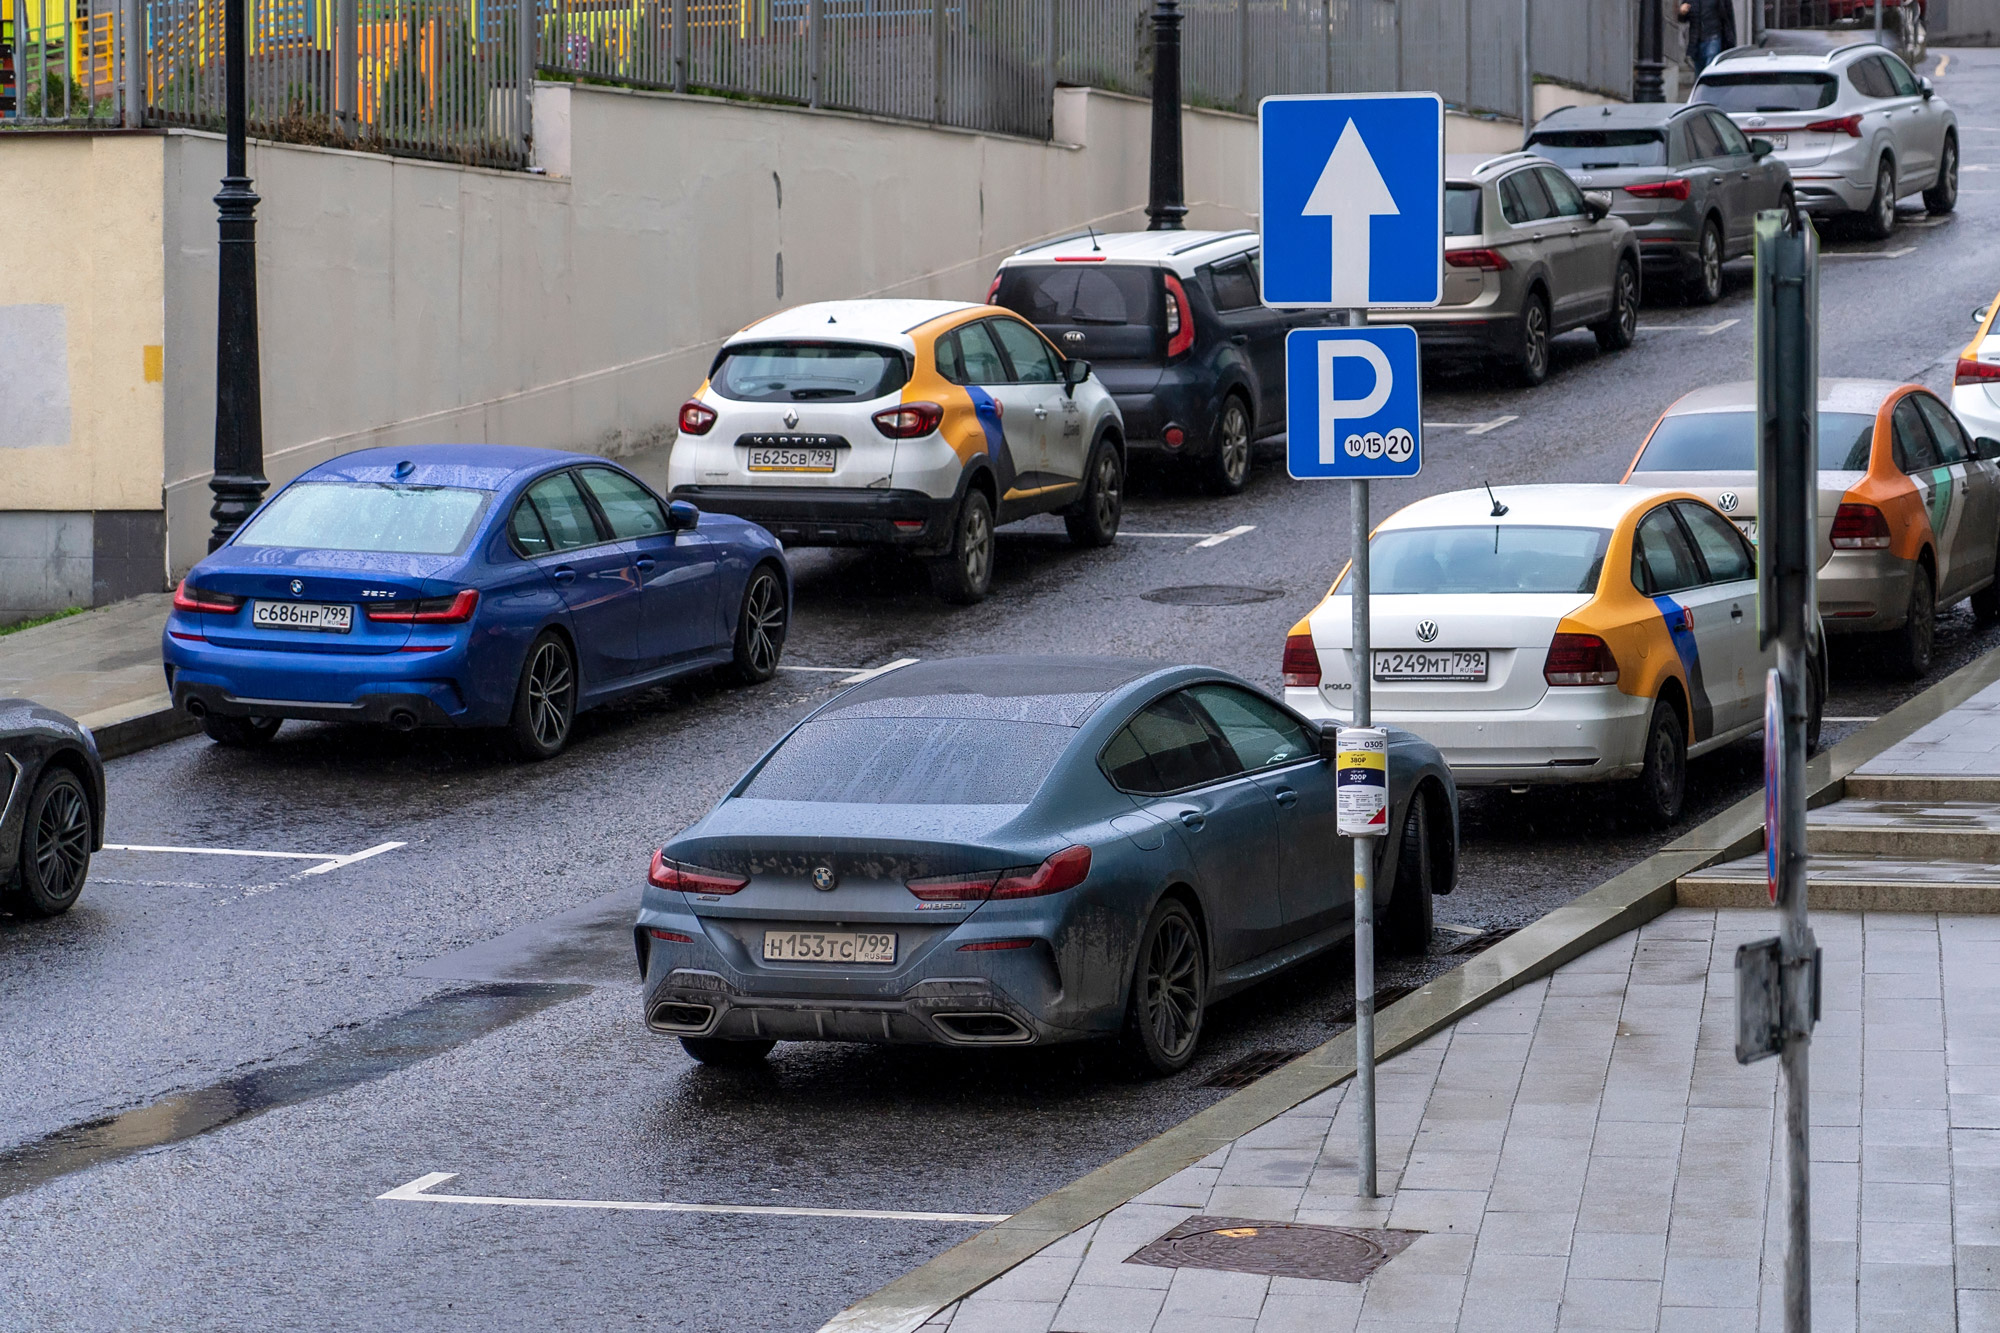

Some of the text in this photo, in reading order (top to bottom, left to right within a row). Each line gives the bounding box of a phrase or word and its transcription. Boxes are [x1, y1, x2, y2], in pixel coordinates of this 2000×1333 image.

[1317, 339, 1393, 464] P
[1348, 435, 1412, 455] 10 15 20
[811, 450, 832, 462] 799
[323, 606, 347, 621] 799
[1454, 653, 1482, 668] 799
[1324, 683, 1352, 691] POLO
[1364, 740, 1384, 748] 0305
[858, 934, 889, 954] 799
[864, 952, 880, 960] RUS
